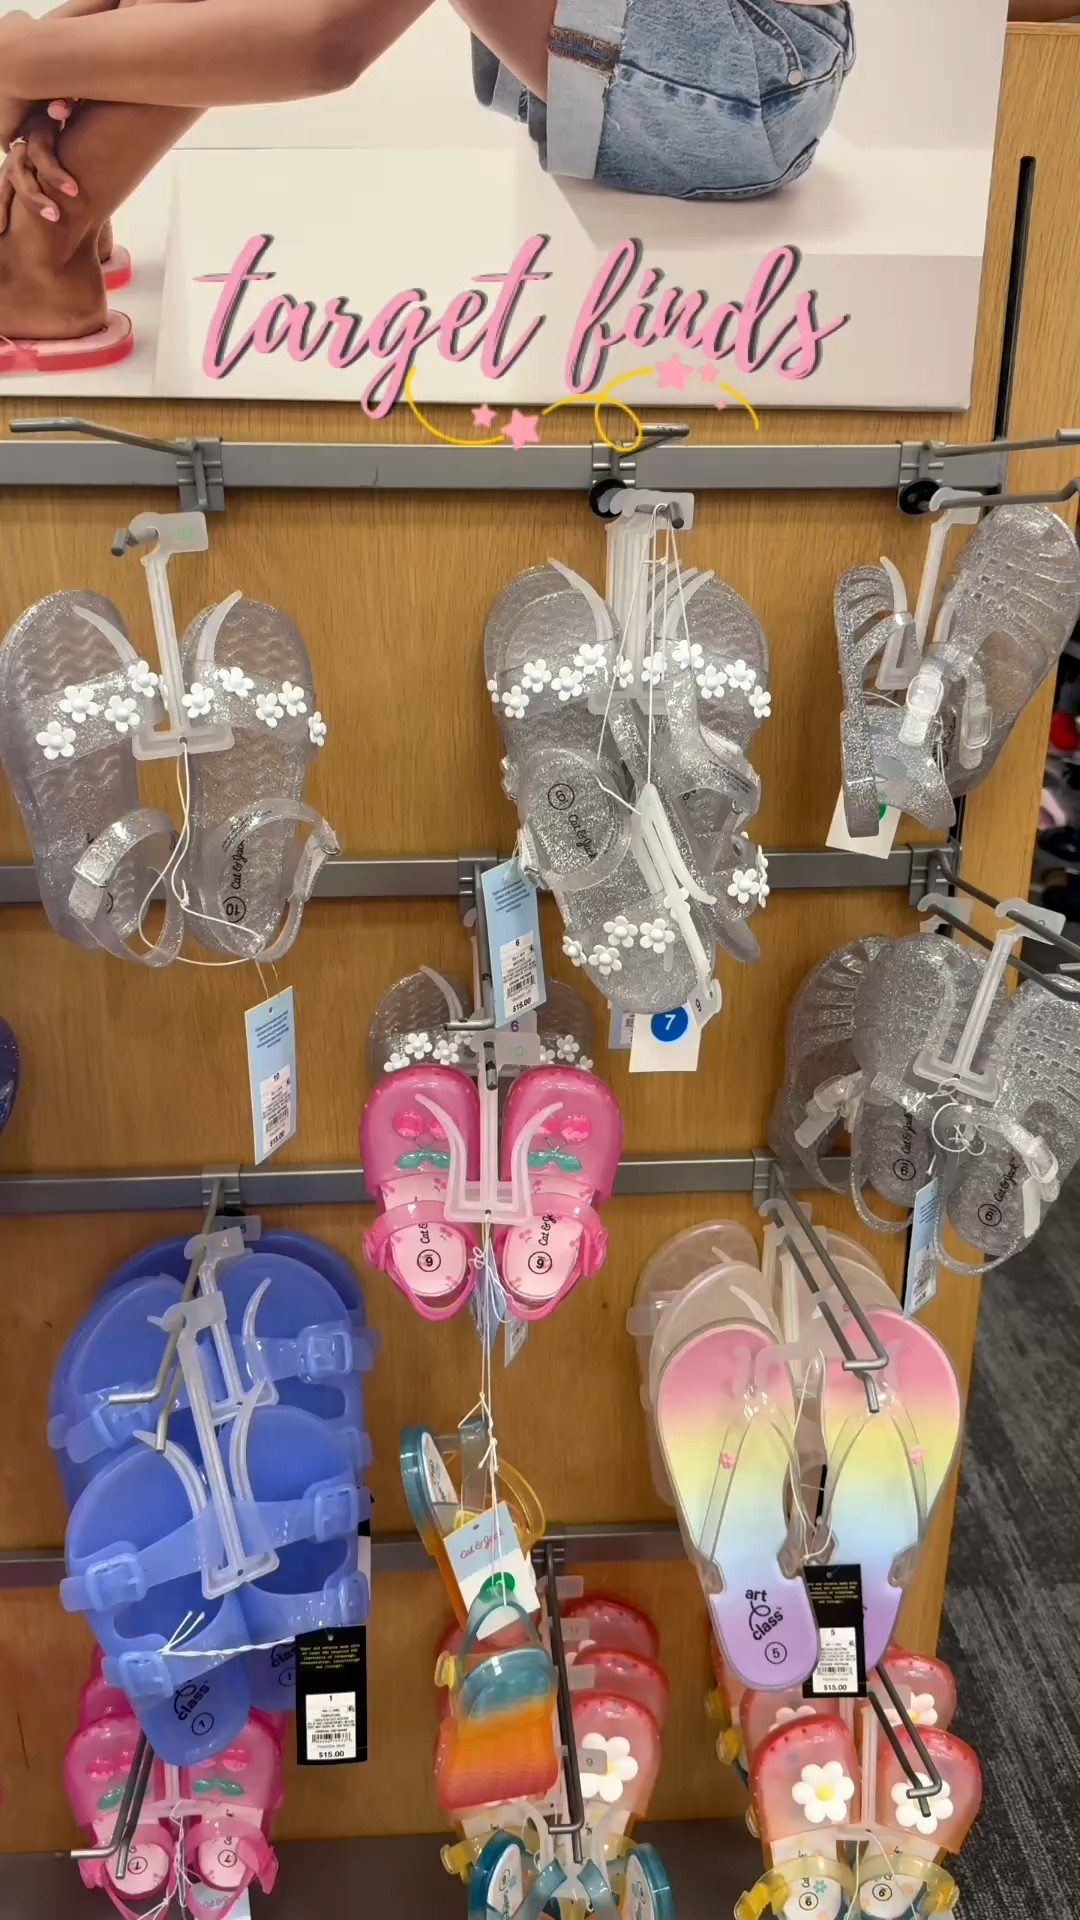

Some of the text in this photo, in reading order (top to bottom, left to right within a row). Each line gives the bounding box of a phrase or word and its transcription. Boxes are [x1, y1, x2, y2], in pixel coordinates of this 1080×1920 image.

[231, 873, 242, 890] Cat
[512, 997, 532, 1013] $15.00
[510, 1020, 519, 1033] 6
[664, 1014, 676, 1031] 7
[269, 1130, 286, 1148] $15.00
[420, 1229, 431, 1244] Cat
[538, 1232, 550, 1247] Cat
[460, 1546, 474, 1560] Cat
[745, 1589, 768, 1602] art
[753, 1611, 784, 1641] class
[830, 1629, 836, 1637] 5
[823, 1684, 848, 1692] $15.00
[178, 1684, 210, 1721] class
[318, 1750, 345, 1758] $15.00
